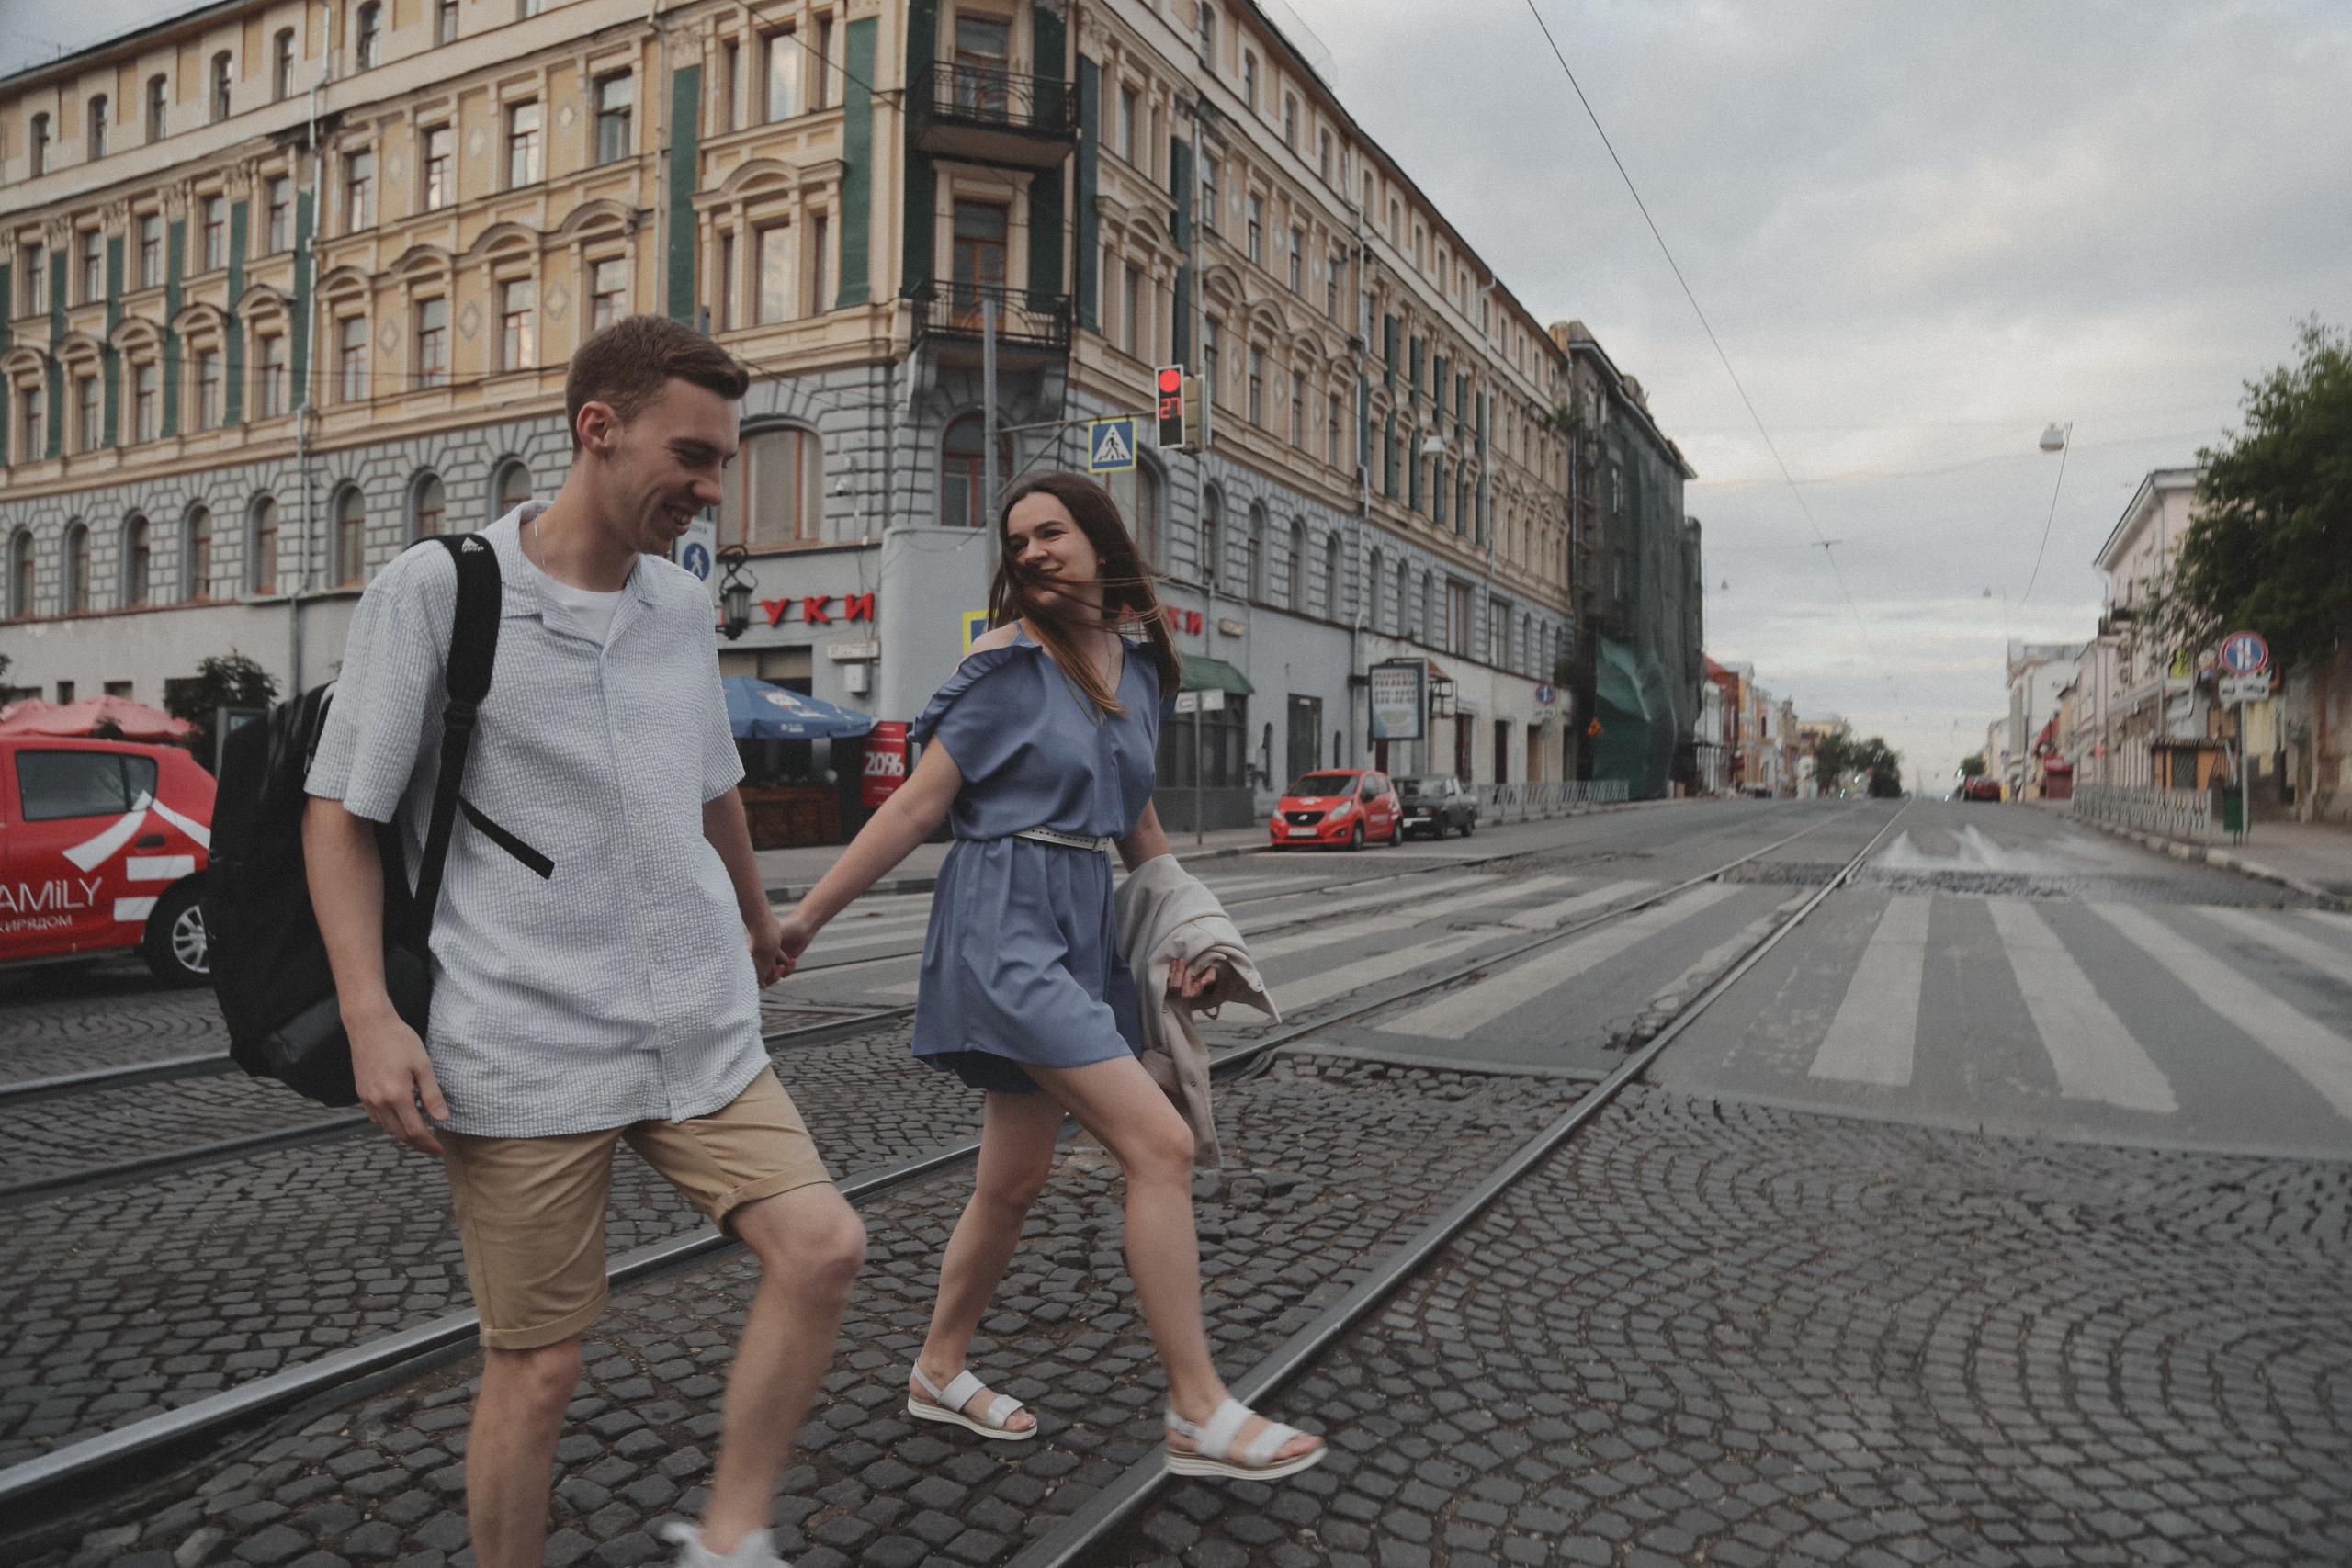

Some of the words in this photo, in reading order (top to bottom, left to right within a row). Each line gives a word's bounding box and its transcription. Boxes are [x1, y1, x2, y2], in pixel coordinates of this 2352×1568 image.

[1159, 397, 1182, 419] 27
[719, 592, 874, 626] УКИ
[865, 751, 905, 777] 20%
